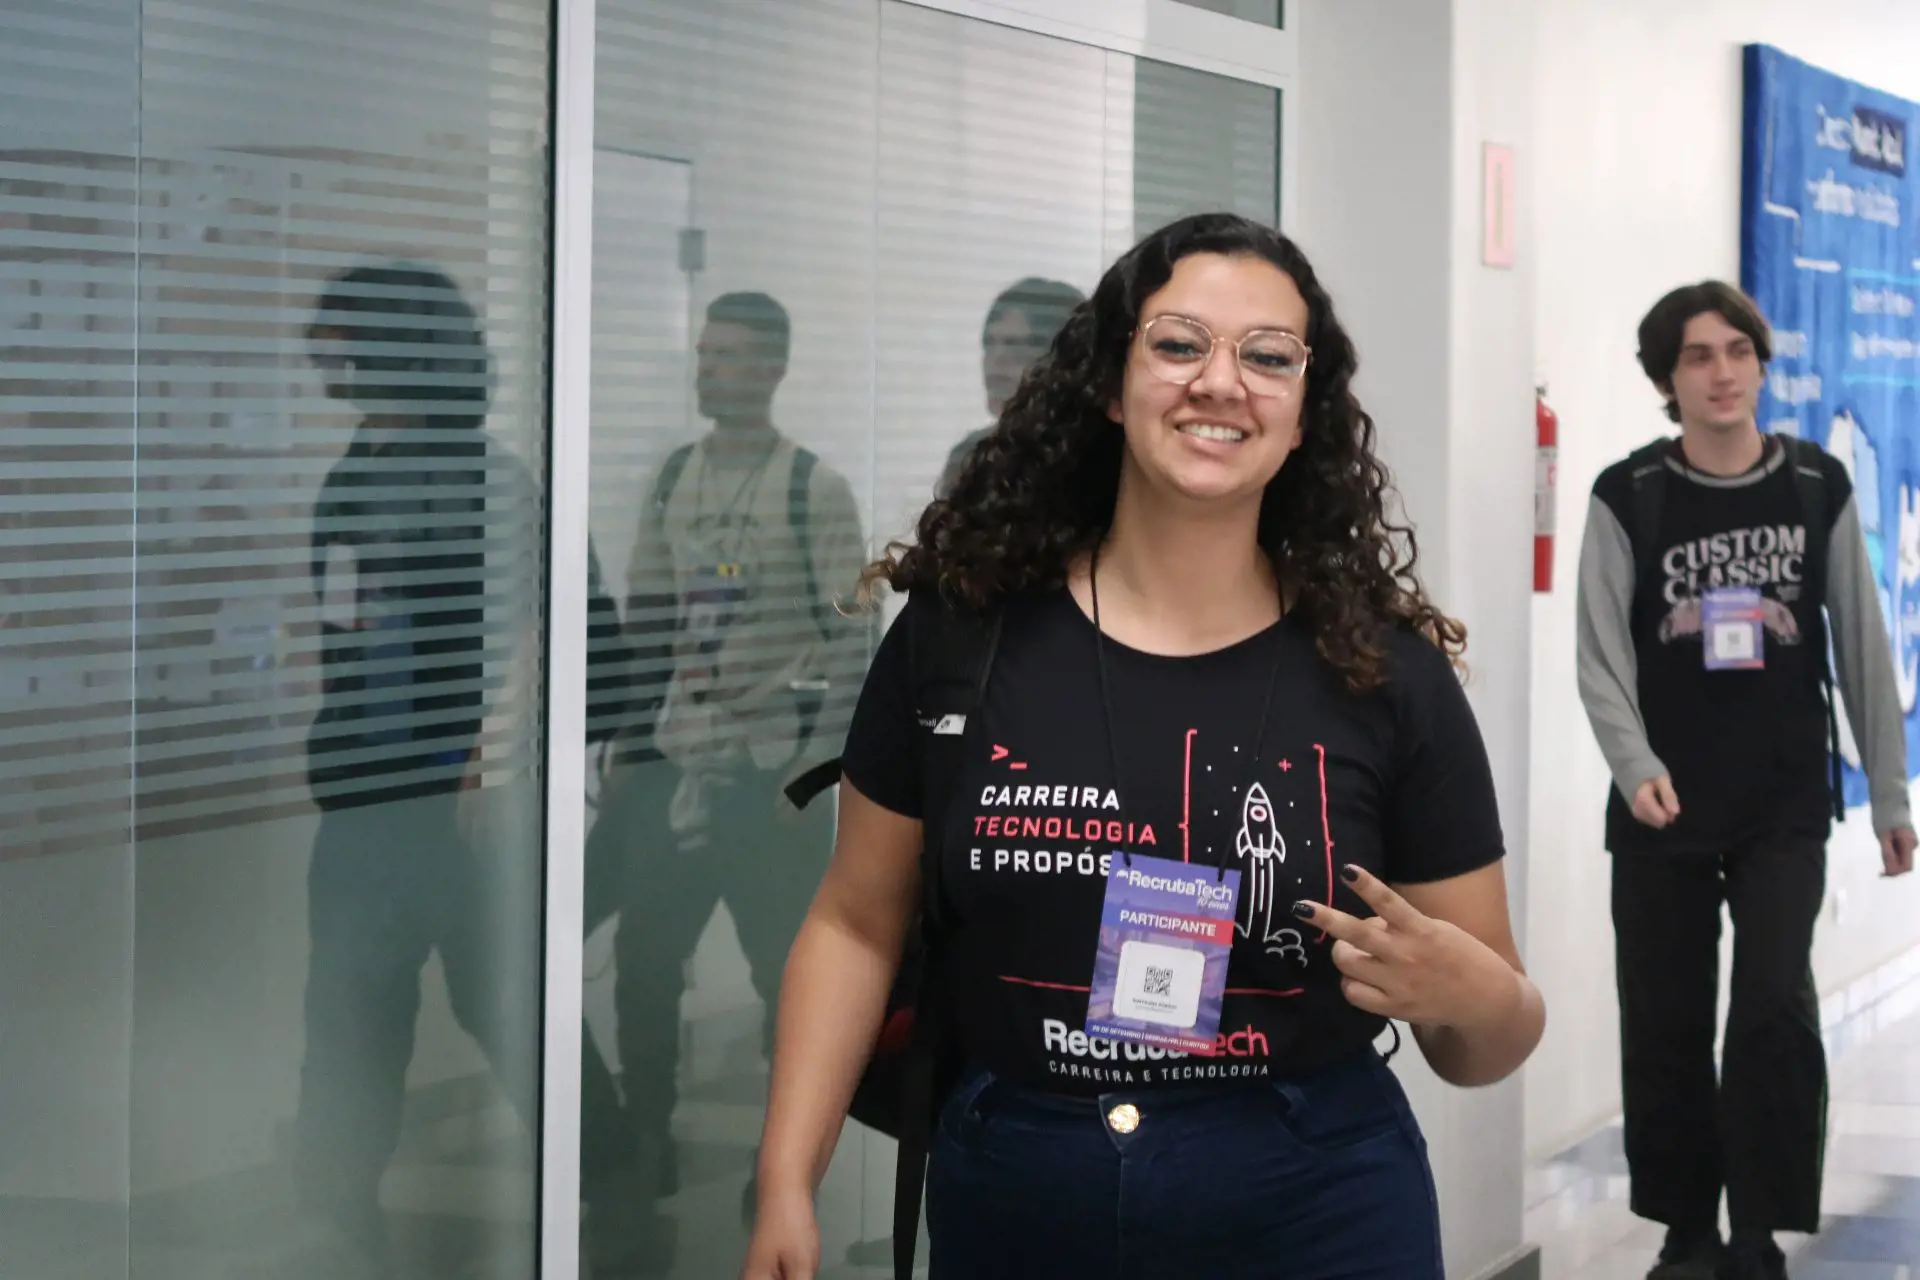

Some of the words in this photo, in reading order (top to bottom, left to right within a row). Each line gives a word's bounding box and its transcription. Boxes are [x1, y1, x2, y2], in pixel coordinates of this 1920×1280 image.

[1662, 524, 1806, 577] CUSTOM
[1664, 553, 1803, 605] CLASSIC
[980, 785, 1120, 811] CARREIRA
[974, 816, 1157, 846] TECNOLOGIA
[970, 848, 982, 870] E
[994, 846, 1112, 877] PROPÓS
[1120, 909, 1217, 937] PARTICIPANTE
[1049, 1059, 1134, 1084] CARREIRA
[1143, 1069, 1152, 1082] E
[1161, 1064, 1269, 1081] TECNOLOGIA
